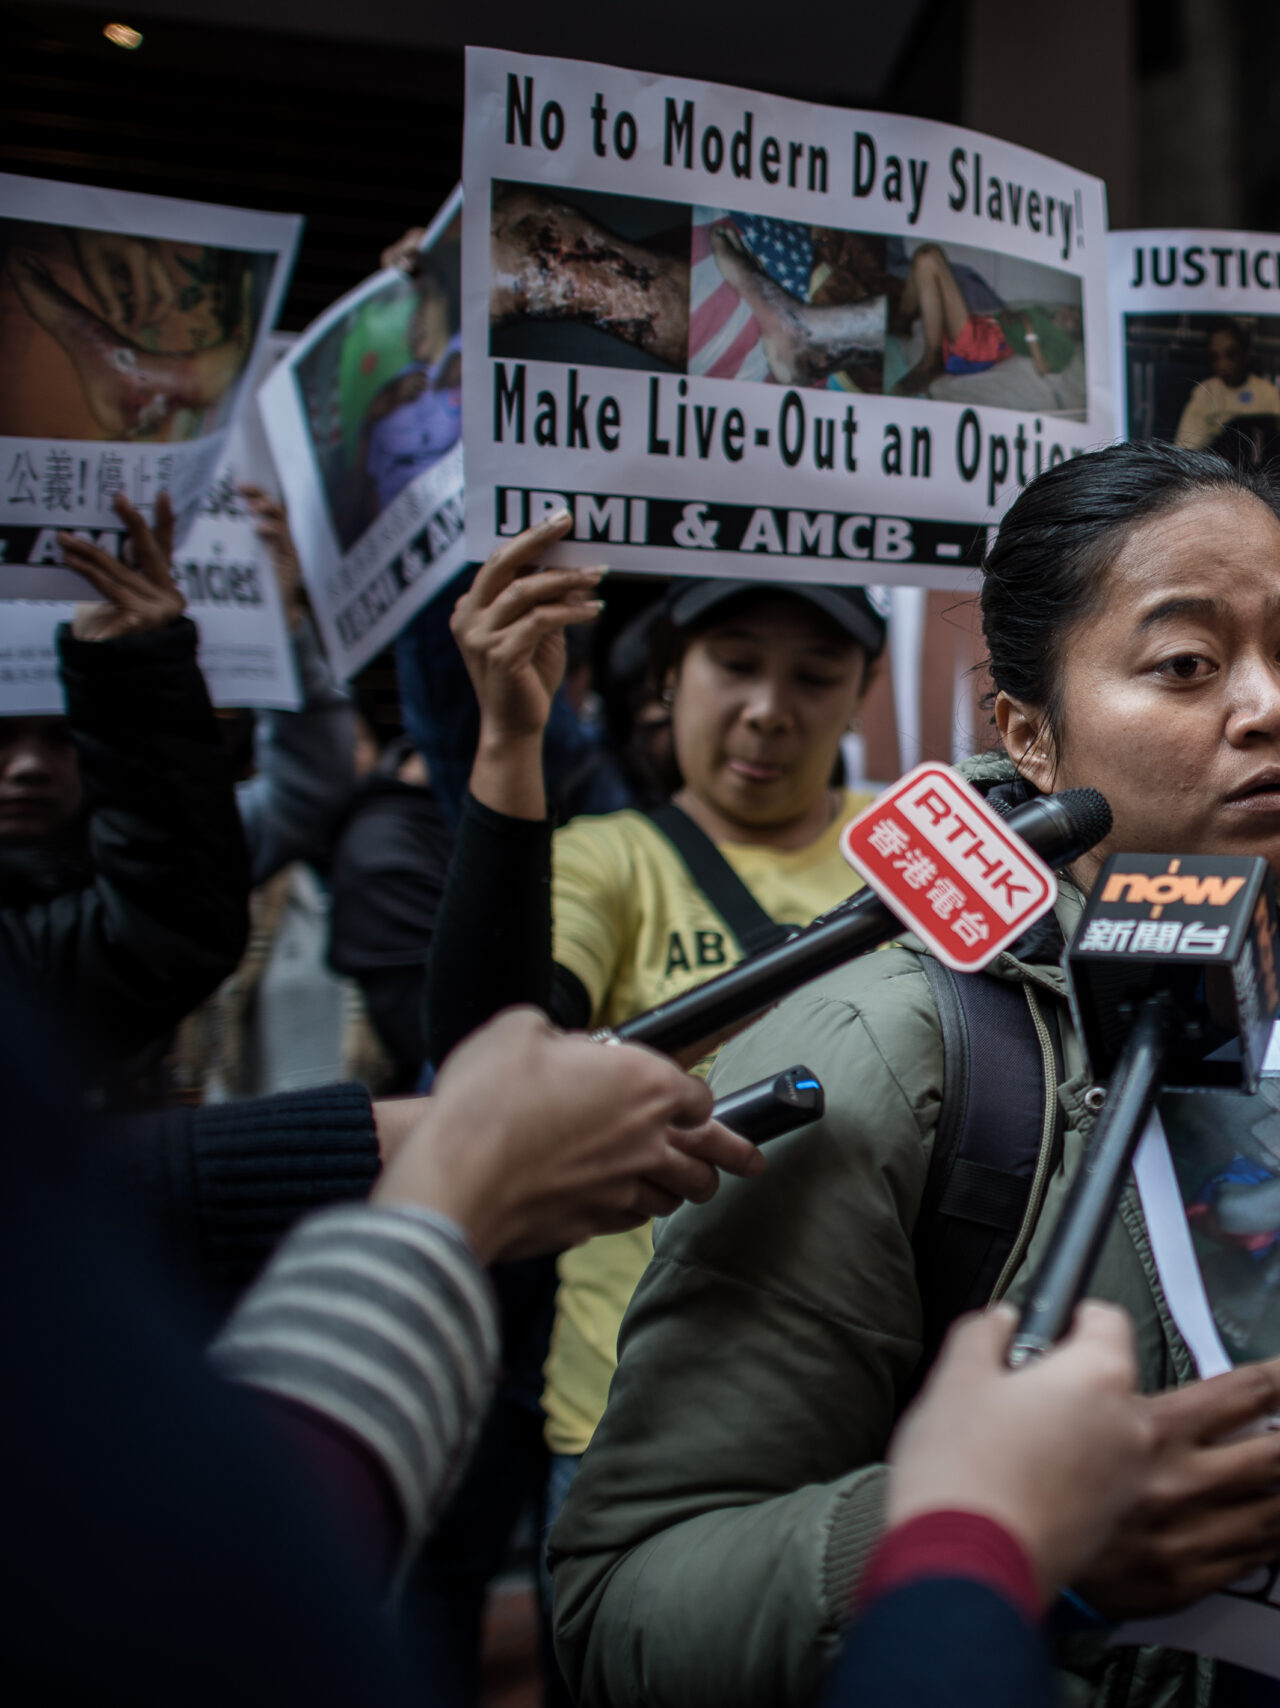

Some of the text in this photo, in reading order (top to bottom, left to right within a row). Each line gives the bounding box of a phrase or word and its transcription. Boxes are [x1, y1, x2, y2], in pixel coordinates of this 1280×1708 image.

[506, 72, 1085, 259] No to Modern Day Slavery!
[493, 362, 1085, 506] Make Live-Out an Optio
[674, 503, 720, 548] &
[740, 508, 914, 560] AMCB
[867, 818, 992, 948] 香港電台
[914, 788, 1031, 911] RTHK
[1101, 865, 1247, 912] now
[665, 930, 738, 978] AB
[1079, 918, 1231, 955] 新聞台
